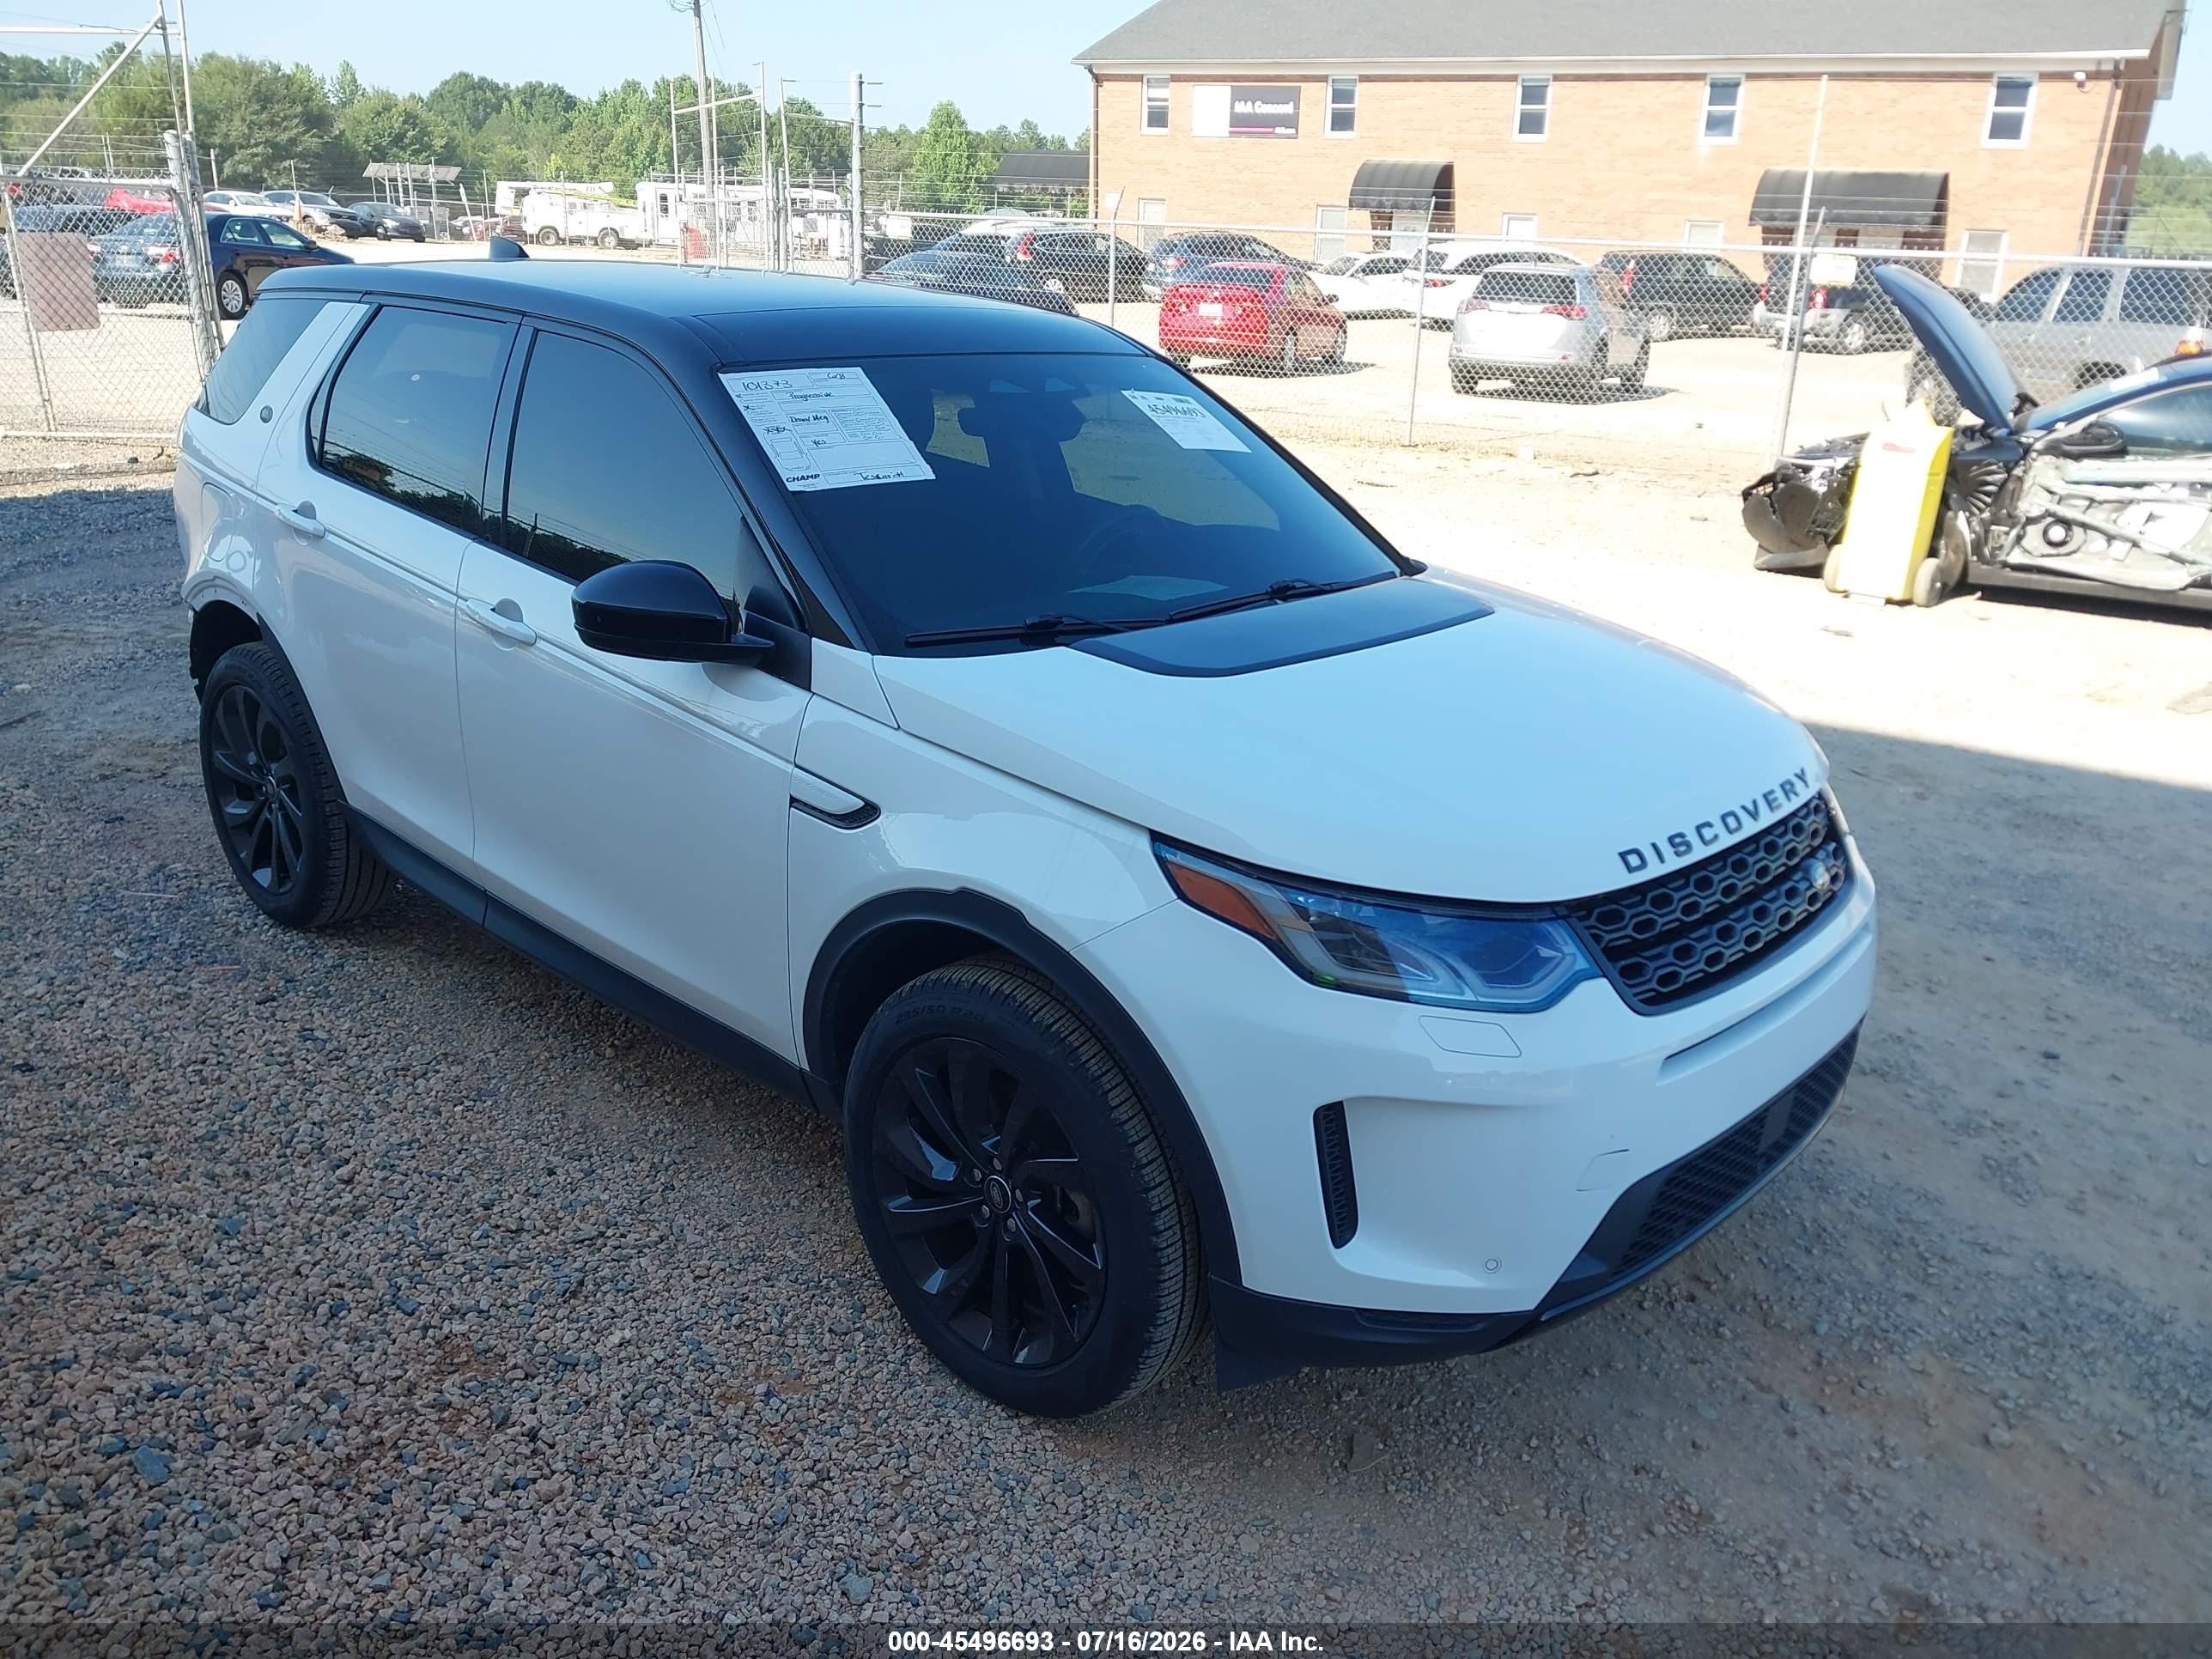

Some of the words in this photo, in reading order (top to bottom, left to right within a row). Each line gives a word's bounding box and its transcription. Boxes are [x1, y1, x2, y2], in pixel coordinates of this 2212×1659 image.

[742, 380, 793, 392] 101373
[786, 473, 821, 483] CHAMP
[1617, 767, 1810, 874] DISCOVERY
